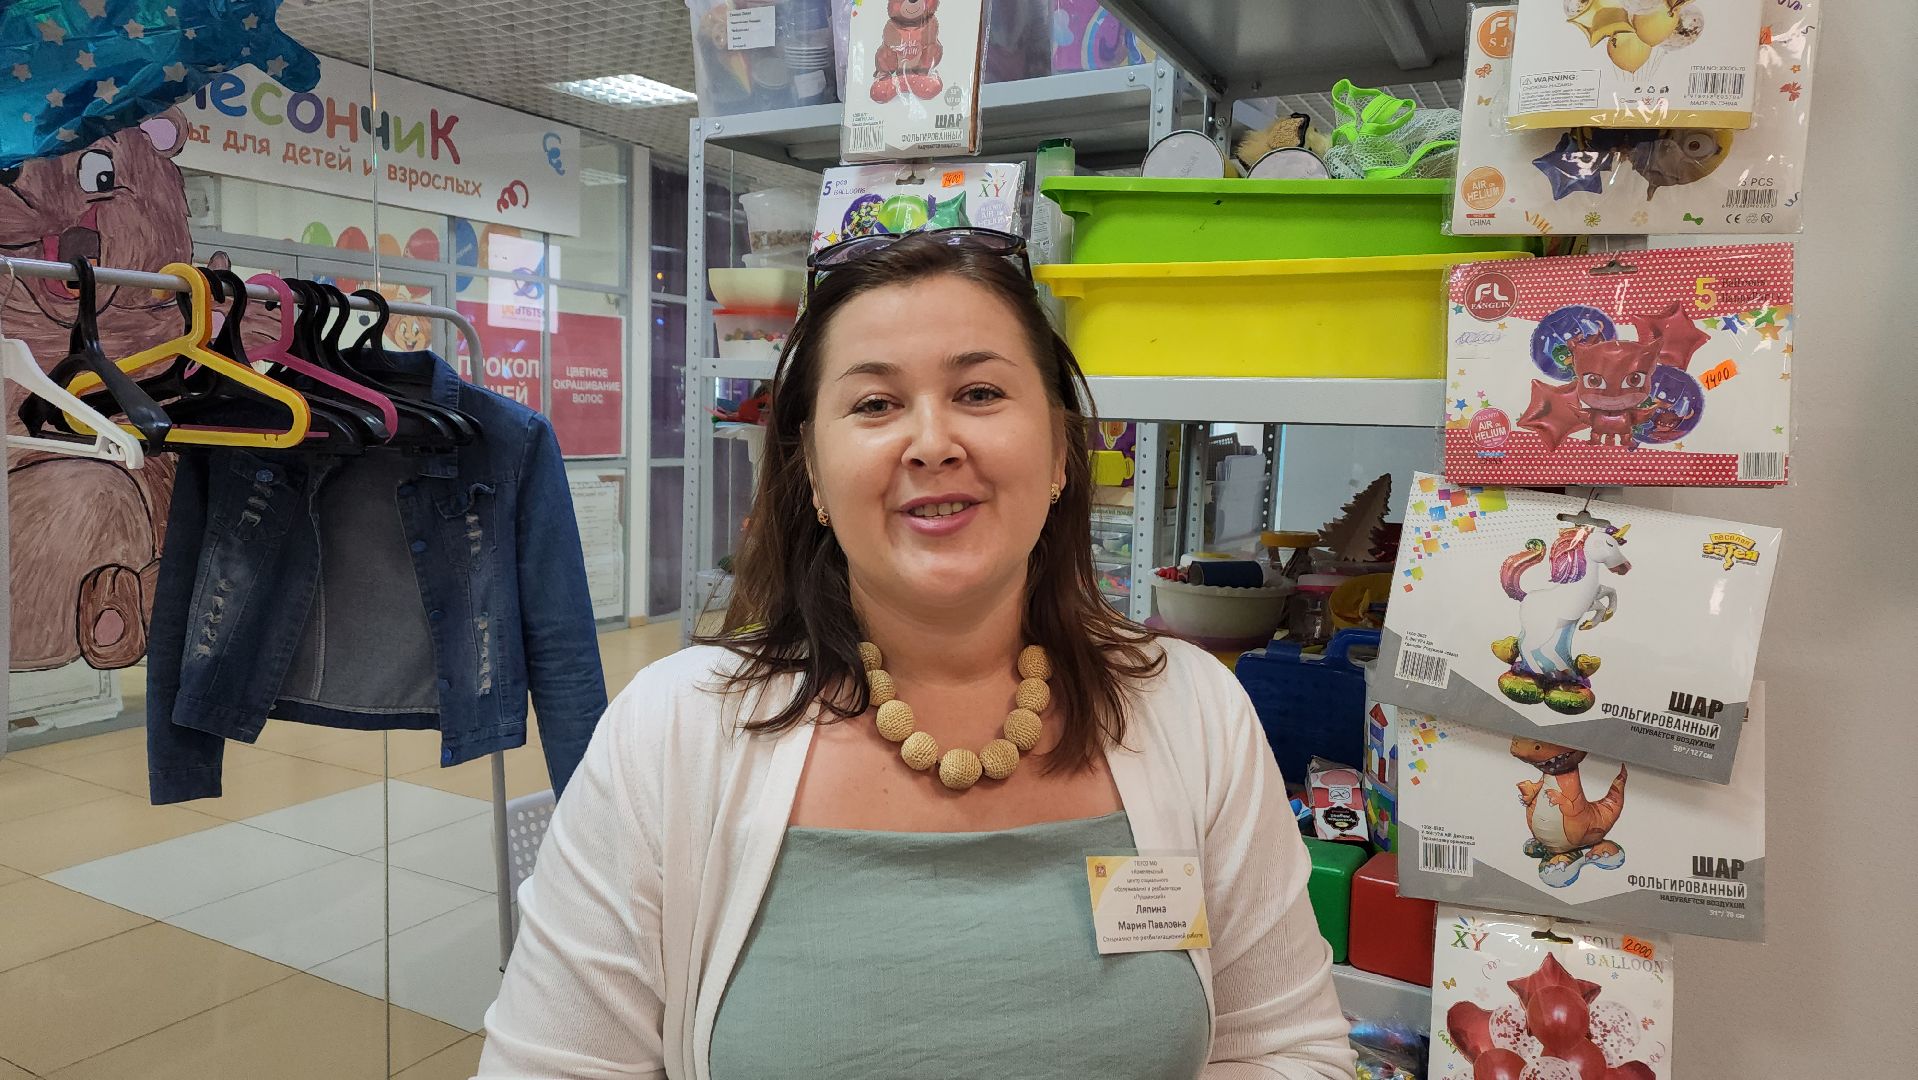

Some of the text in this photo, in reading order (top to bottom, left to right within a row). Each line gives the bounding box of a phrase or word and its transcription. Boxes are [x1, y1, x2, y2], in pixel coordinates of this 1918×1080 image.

[222, 128, 271, 156] для
[282, 141, 351, 174] детей
[387, 163, 483, 198] взрослых
[822, 180, 833, 196] 5
[1472, 180, 1487, 190] AIR
[1750, 177, 1774, 187] PCS
[1469, 219, 1492, 227] CHINA
[1474, 282, 1509, 303] FL
[1694, 277, 1718, 311] 5
[1470, 301, 1512, 310] FANGLIN
[457, 354, 540, 380] ПОКОЛ
[565, 365, 609, 379] ЦВЕТНОЕ
[553, 378, 622, 393] ОКРАШИВАНИЕ
[1704, 367, 1730, 391] 1400
[572, 392, 604, 404] ВОЛОС
[1474, 426, 1507, 442] HELIUM
[1478, 420, 1493, 432] AIR
[1668, 690, 1724, 720] ШАР
[1601, 702, 1720, 740] ФОЛЬГИРОВАННЫЙ
[1630, 725, 1716, 750] НАДУВАЕТСЯ ВОЗДУХОМ
[1692, 855, 1745, 880] ШАР
[1627, 874, 1746, 898] ФОЛЬГИРОВАННЫЙ
[1135, 904, 1167, 914] Ляпина
[1660, 894, 1745, 910] НАДУВАЕТСЯ ВОЗДУХОМ
[1118, 919, 1187, 932] Мария Павловна
[1623, 938, 1653, 959] 2000
[1585, 952, 1665, 974] BALLOON
